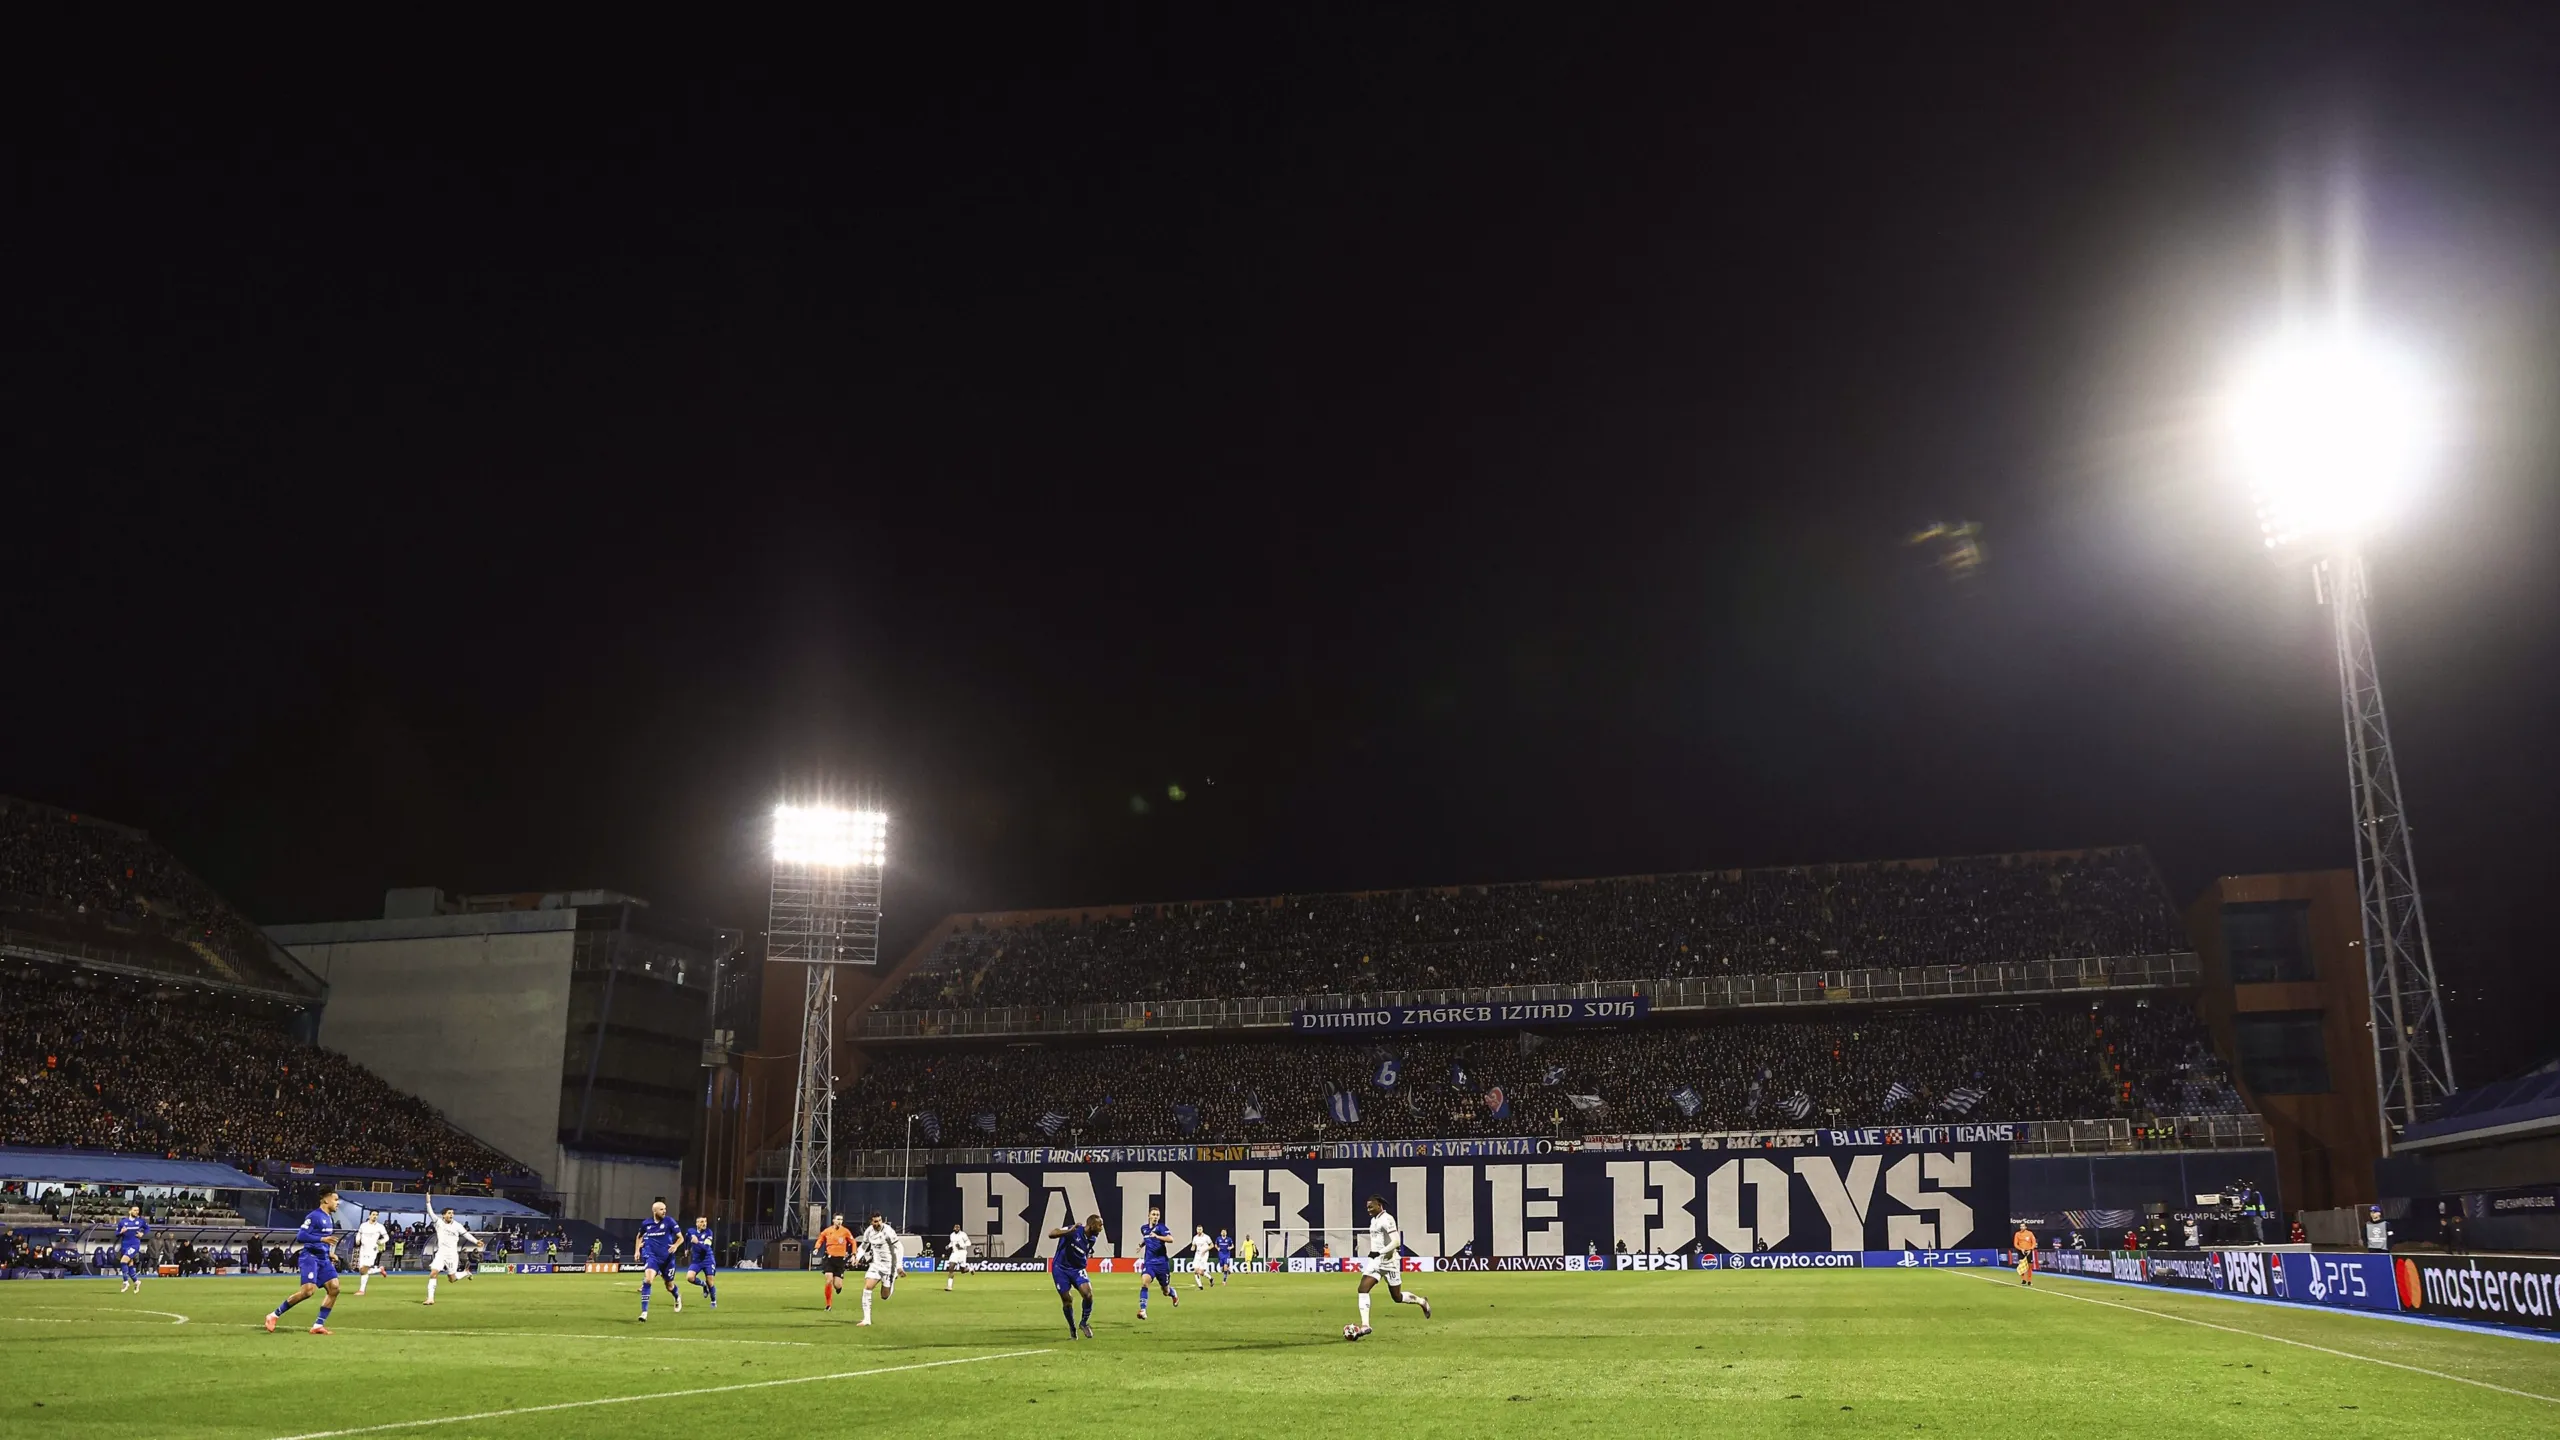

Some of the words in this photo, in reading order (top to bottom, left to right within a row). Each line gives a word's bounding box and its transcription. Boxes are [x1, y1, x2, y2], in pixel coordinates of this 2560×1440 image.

[1303, 1011, 1391, 1028] DINAMO
[1402, 1007, 1492, 1024] ZAGREB
[1501, 1003, 1573, 1020] IZNAD
[1584, 1001, 1636, 1018] SVIH
[1636, 1139, 1690, 1151] WELCOE
[1831, 1129, 1882, 1146] BLUE
[1197, 1147, 1244, 1161] BSN
[1338, 1141, 1413, 1158] DINAMO
[1432, 1140, 1530, 1156] SVETINJA
[1008, 1150, 1042, 1164] BLUE
[956, 1171, 1193, 1258] BAD
[1229, 1163, 1564, 1258] BLUE
[1606, 1152, 1974, 1255] BOYS
[2174, 1210, 2235, 1222] CHAMPINS
[901, 1260, 931, 1269] CYCLE
[943, 1260, 1045, 1271] FowScores.com
[1173, 1258, 1266, 1273] Henken
[1316, 1257, 1360, 1272] FedEx
[1435, 1258, 1489, 1272] QATAR
[1496, 1257, 1564, 1271] AIRWAYS
[1616, 1254, 1688, 1271] PEPSI
[1750, 1252, 1854, 1269] crypto.com
[1923, 1252, 1972, 1264] PS5
[2111, 1250, 2143, 1281] Heineken
[559, 1264, 586, 1272] mastercard
[2224, 1252, 2268, 1295] PEPSI
[2325, 1262, 2367, 1297] PS5
